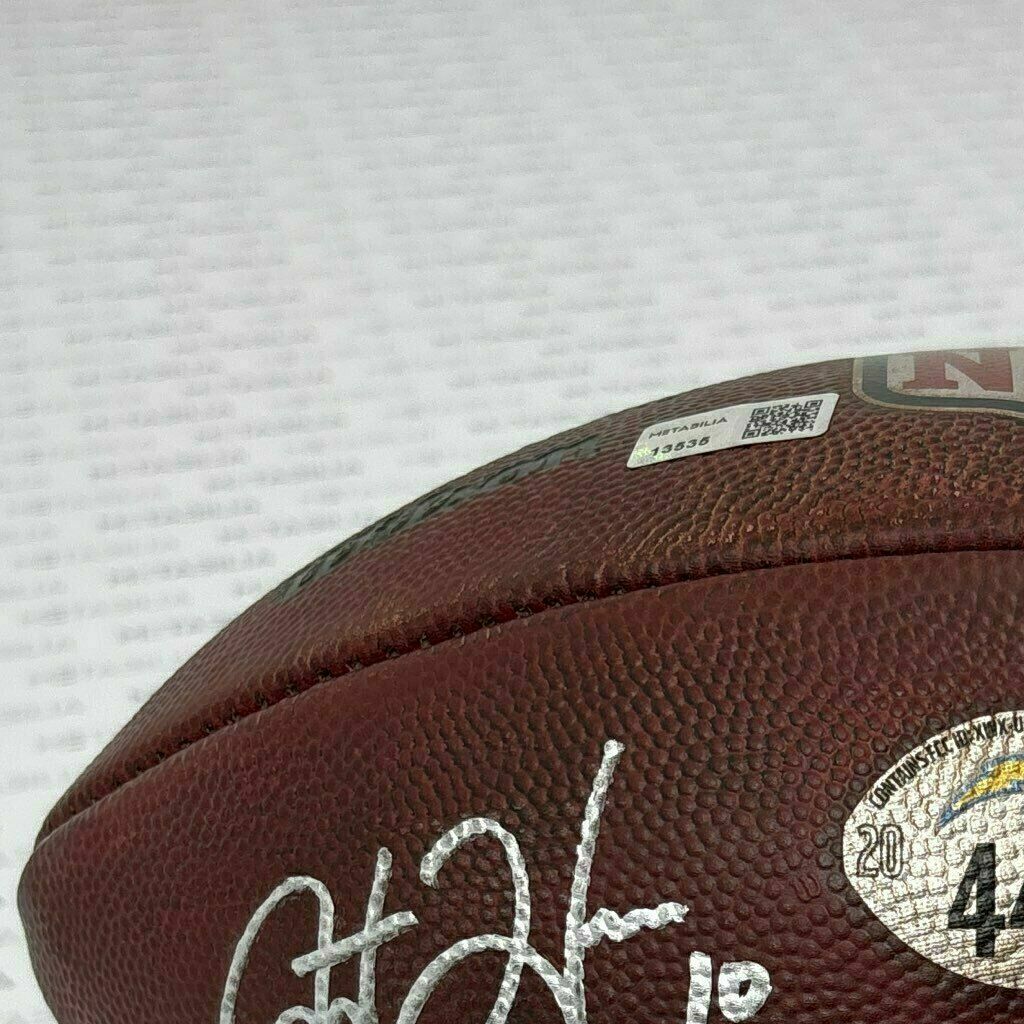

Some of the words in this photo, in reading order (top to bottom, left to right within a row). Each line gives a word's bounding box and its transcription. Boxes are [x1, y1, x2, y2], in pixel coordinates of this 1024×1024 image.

[648, 416, 728, 439] METABILIA
[651, 436, 711, 456] 13535
[869, 751, 929, 810] CONTAINS
[925, 737, 954, 764] FCC
[856, 823, 904, 878] 20
